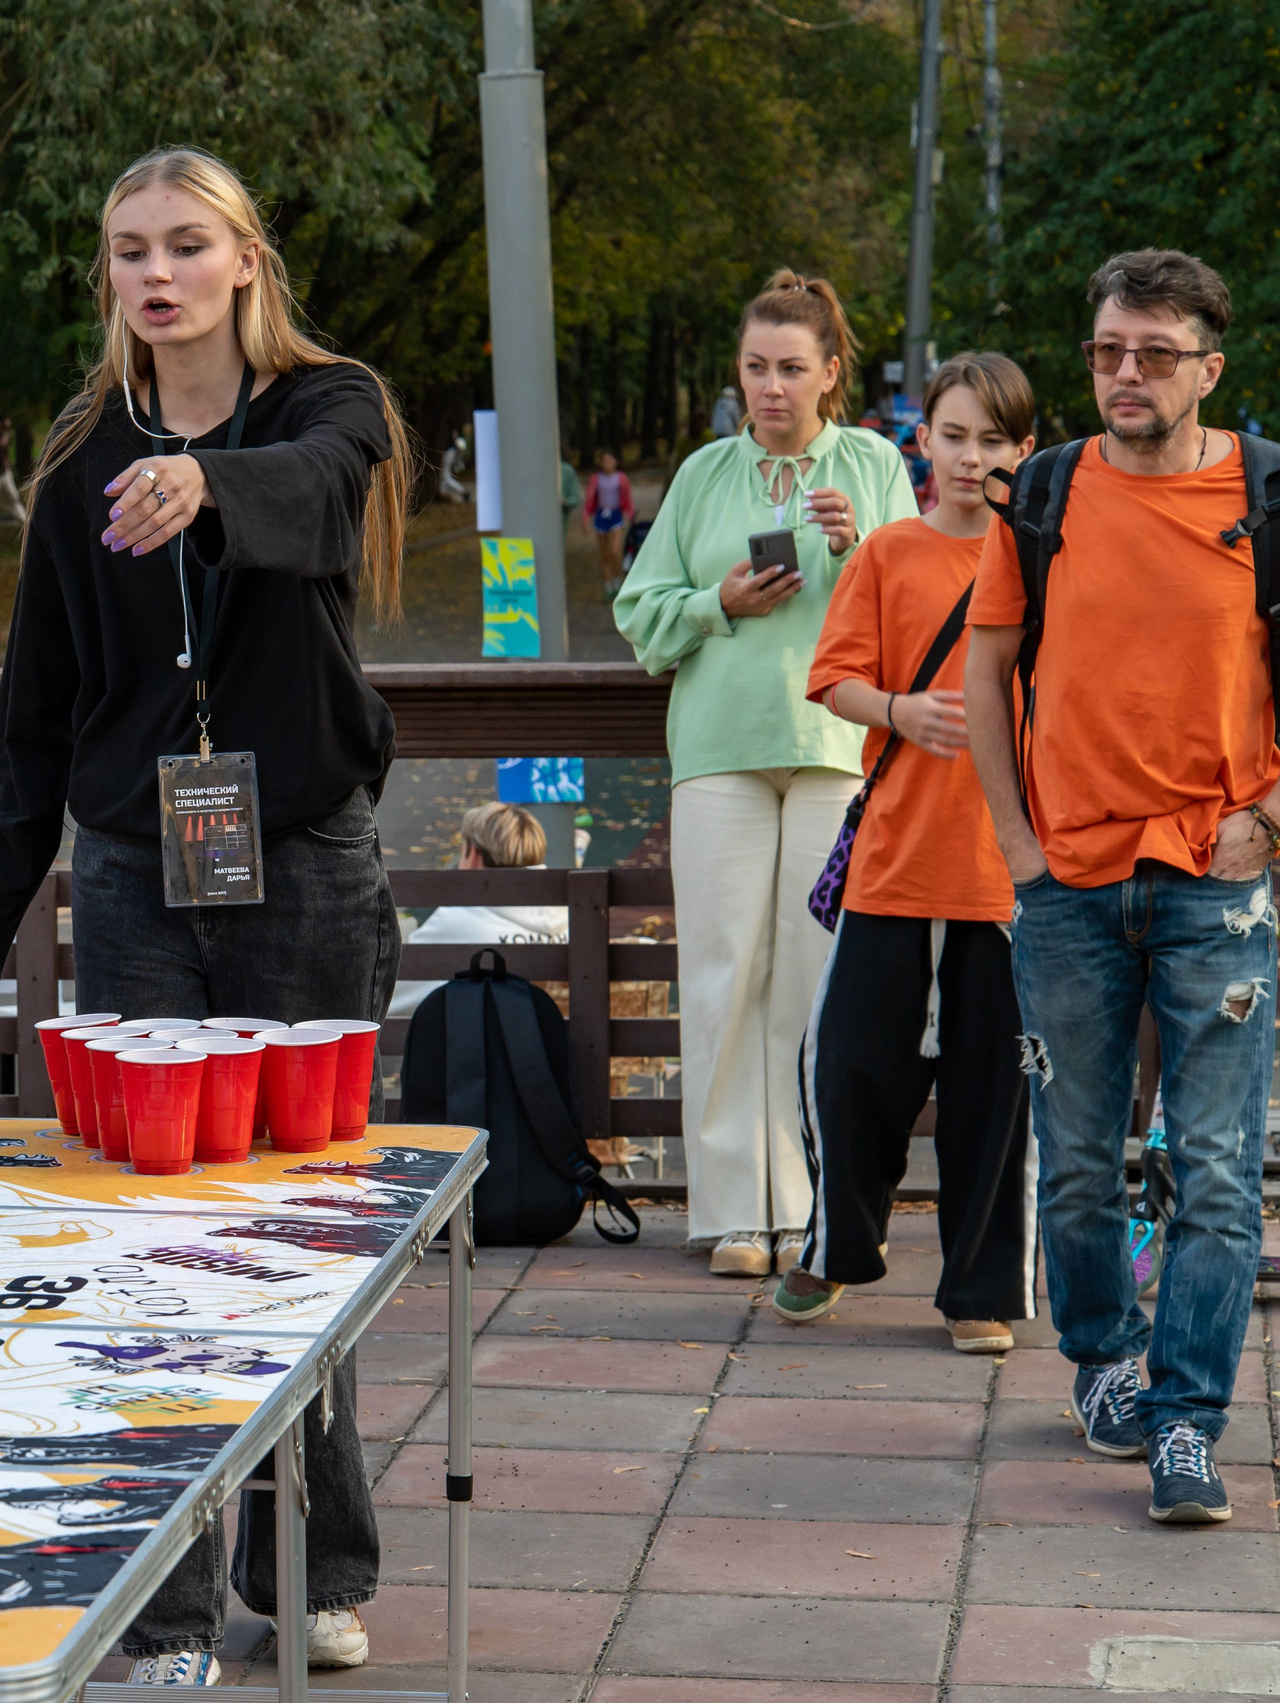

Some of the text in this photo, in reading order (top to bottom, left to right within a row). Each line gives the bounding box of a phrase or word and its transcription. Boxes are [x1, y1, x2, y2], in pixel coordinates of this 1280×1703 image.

[174, 784, 239, 797] ТЕХНИЧЕСКИЙ
[175, 797, 235, 808] СПЕЦИАЛИСТ
[214, 867, 250, 875] МАТВЕЕВА
[226, 874, 251, 882] ДАРЬЯ
[74, 1387, 213, 1411] CENTER
